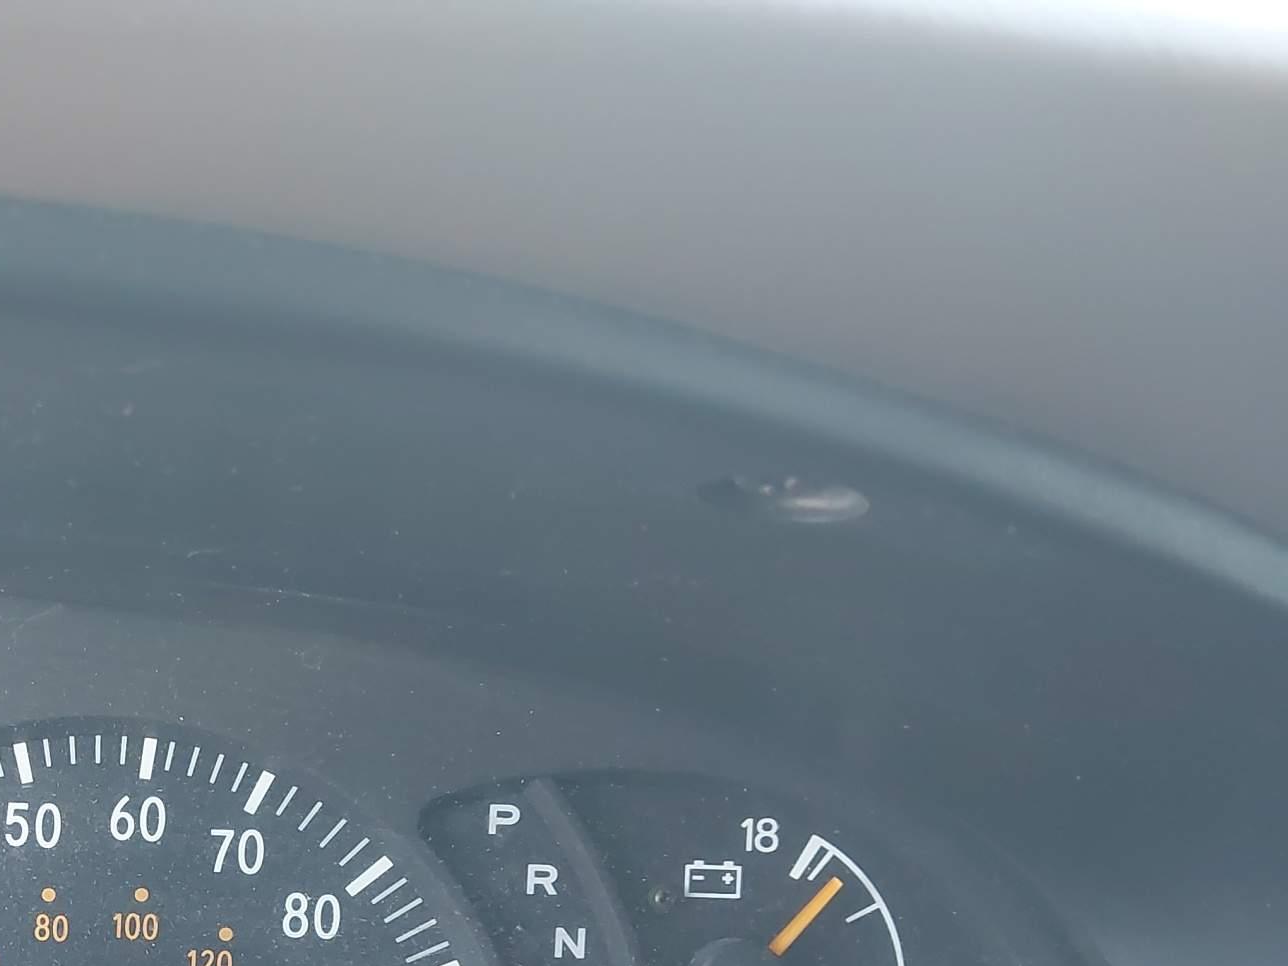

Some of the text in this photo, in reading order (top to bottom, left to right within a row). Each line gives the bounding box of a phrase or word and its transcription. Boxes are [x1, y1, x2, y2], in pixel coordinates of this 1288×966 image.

[5, 803, 63, 849] 50
[109, 796, 167, 843] 60
[487, 803, 521, 834] P
[740, 818, 779, 853] 18
[211, 829, 266, 875] 70
[525, 863, 559, 896] R
[33, 914, 69, 943] 80
[112, 913, 160, 941] 100
[282, 892, 342, 940] 80
[553, 927, 586, 959] N
